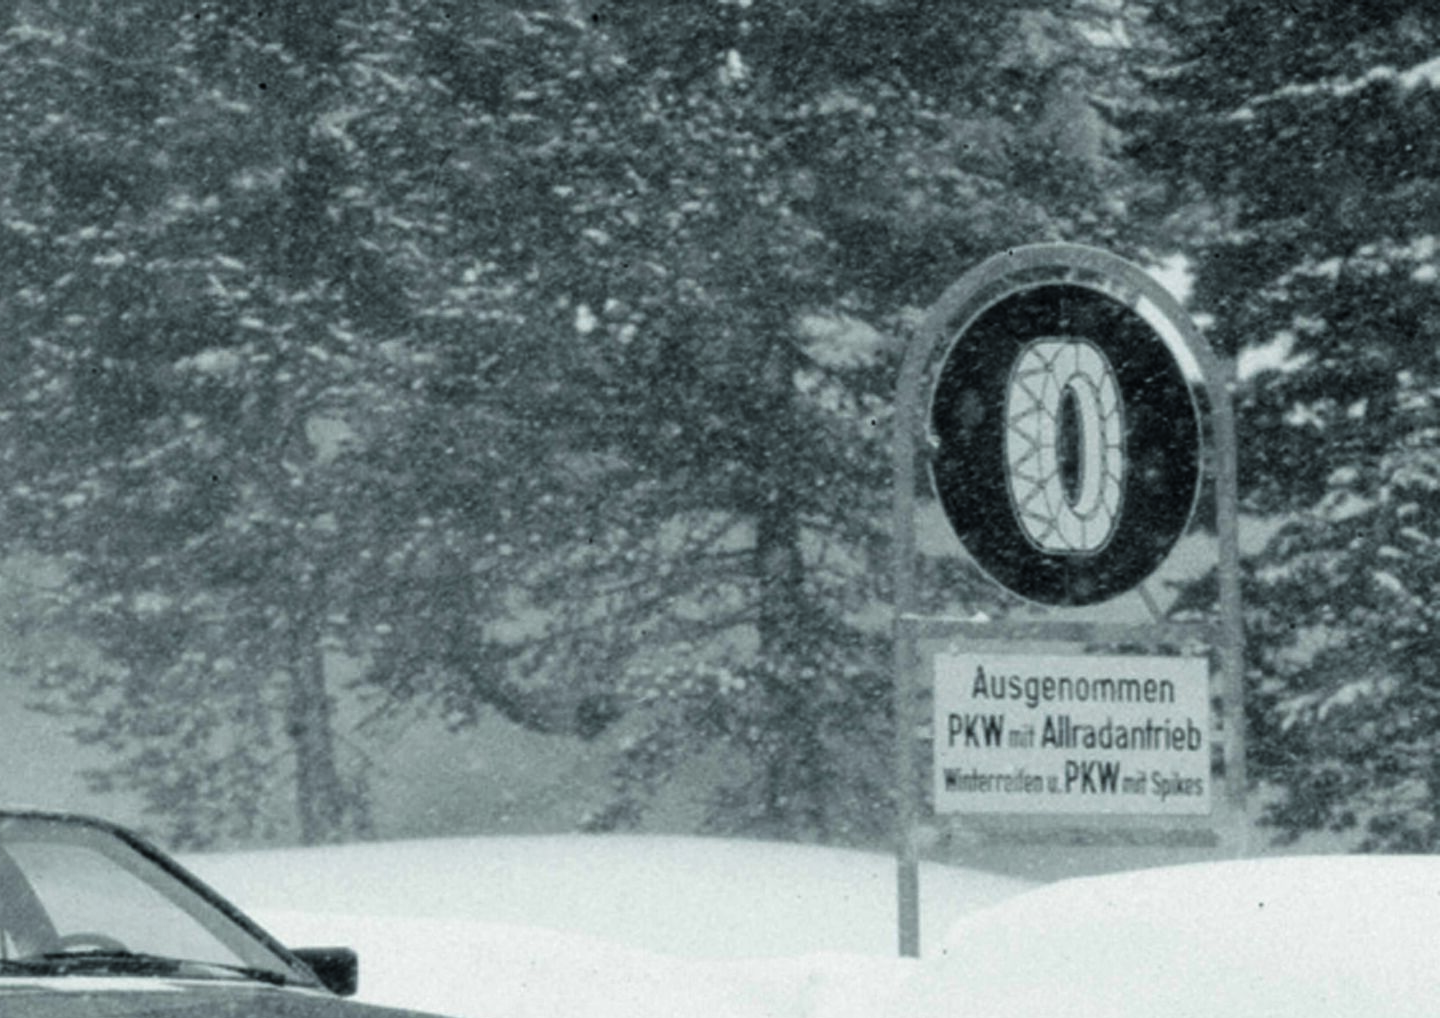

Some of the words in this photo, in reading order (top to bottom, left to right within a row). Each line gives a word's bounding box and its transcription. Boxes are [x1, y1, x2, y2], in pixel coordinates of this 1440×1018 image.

[971, 665, 1175, 708] Ausgenommen
[948, 713, 1005, 748] PKW
[1008, 724, 1035, 748] mit
[1040, 715, 1202, 751] Allradantrieb
[944, 767, 1044, 793] Winterreifen
[1064, 760, 1120, 794] PKW
[1122, 771, 1148, 795] mit
[1151, 771, 1204, 800] Spikes
